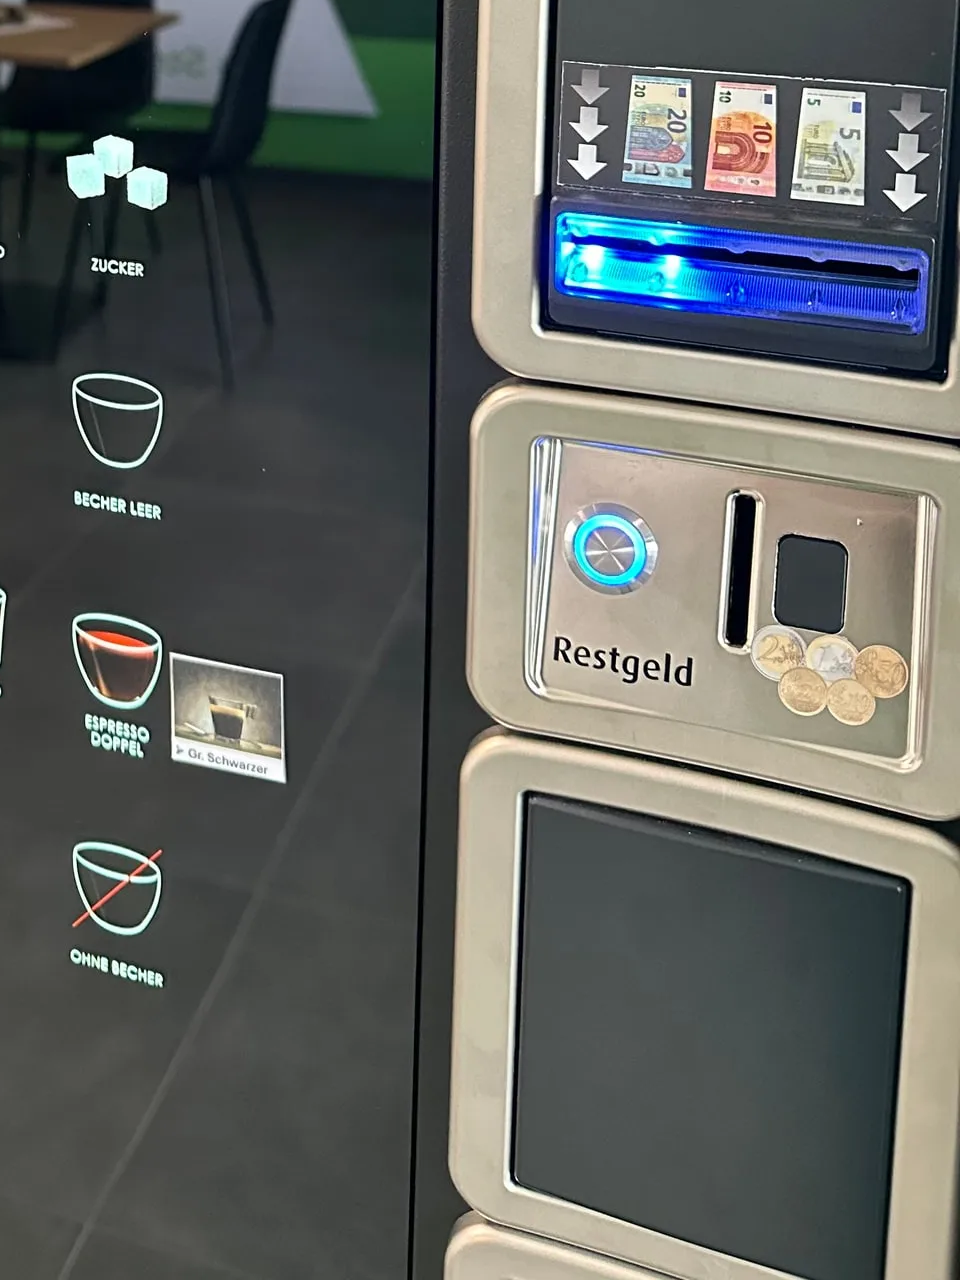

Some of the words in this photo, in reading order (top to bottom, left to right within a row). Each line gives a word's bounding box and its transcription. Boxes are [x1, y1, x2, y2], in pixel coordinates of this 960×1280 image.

[634, 84, 646, 98] 20
[719, 90, 732, 103] 10
[807, 98, 821, 106] 5
[667, 108, 687, 133] 20
[753, 122, 773, 144] 10
[839, 127, 861, 140] 5
[91, 257, 144, 277] ZUCKER
[73, 490, 127, 514] BECHER
[129, 500, 162, 521] LEER
[553, 636, 694, 688] Restgeld
[84, 713, 150, 744] ESPRESSO
[90, 730, 145, 759] DOPPEL
[188, 748, 204, 761] Gr.
[207, 752, 268, 774] Schwarzer
[70, 948, 109, 973] OHNE
[111, 959, 164, 988] BECHER
